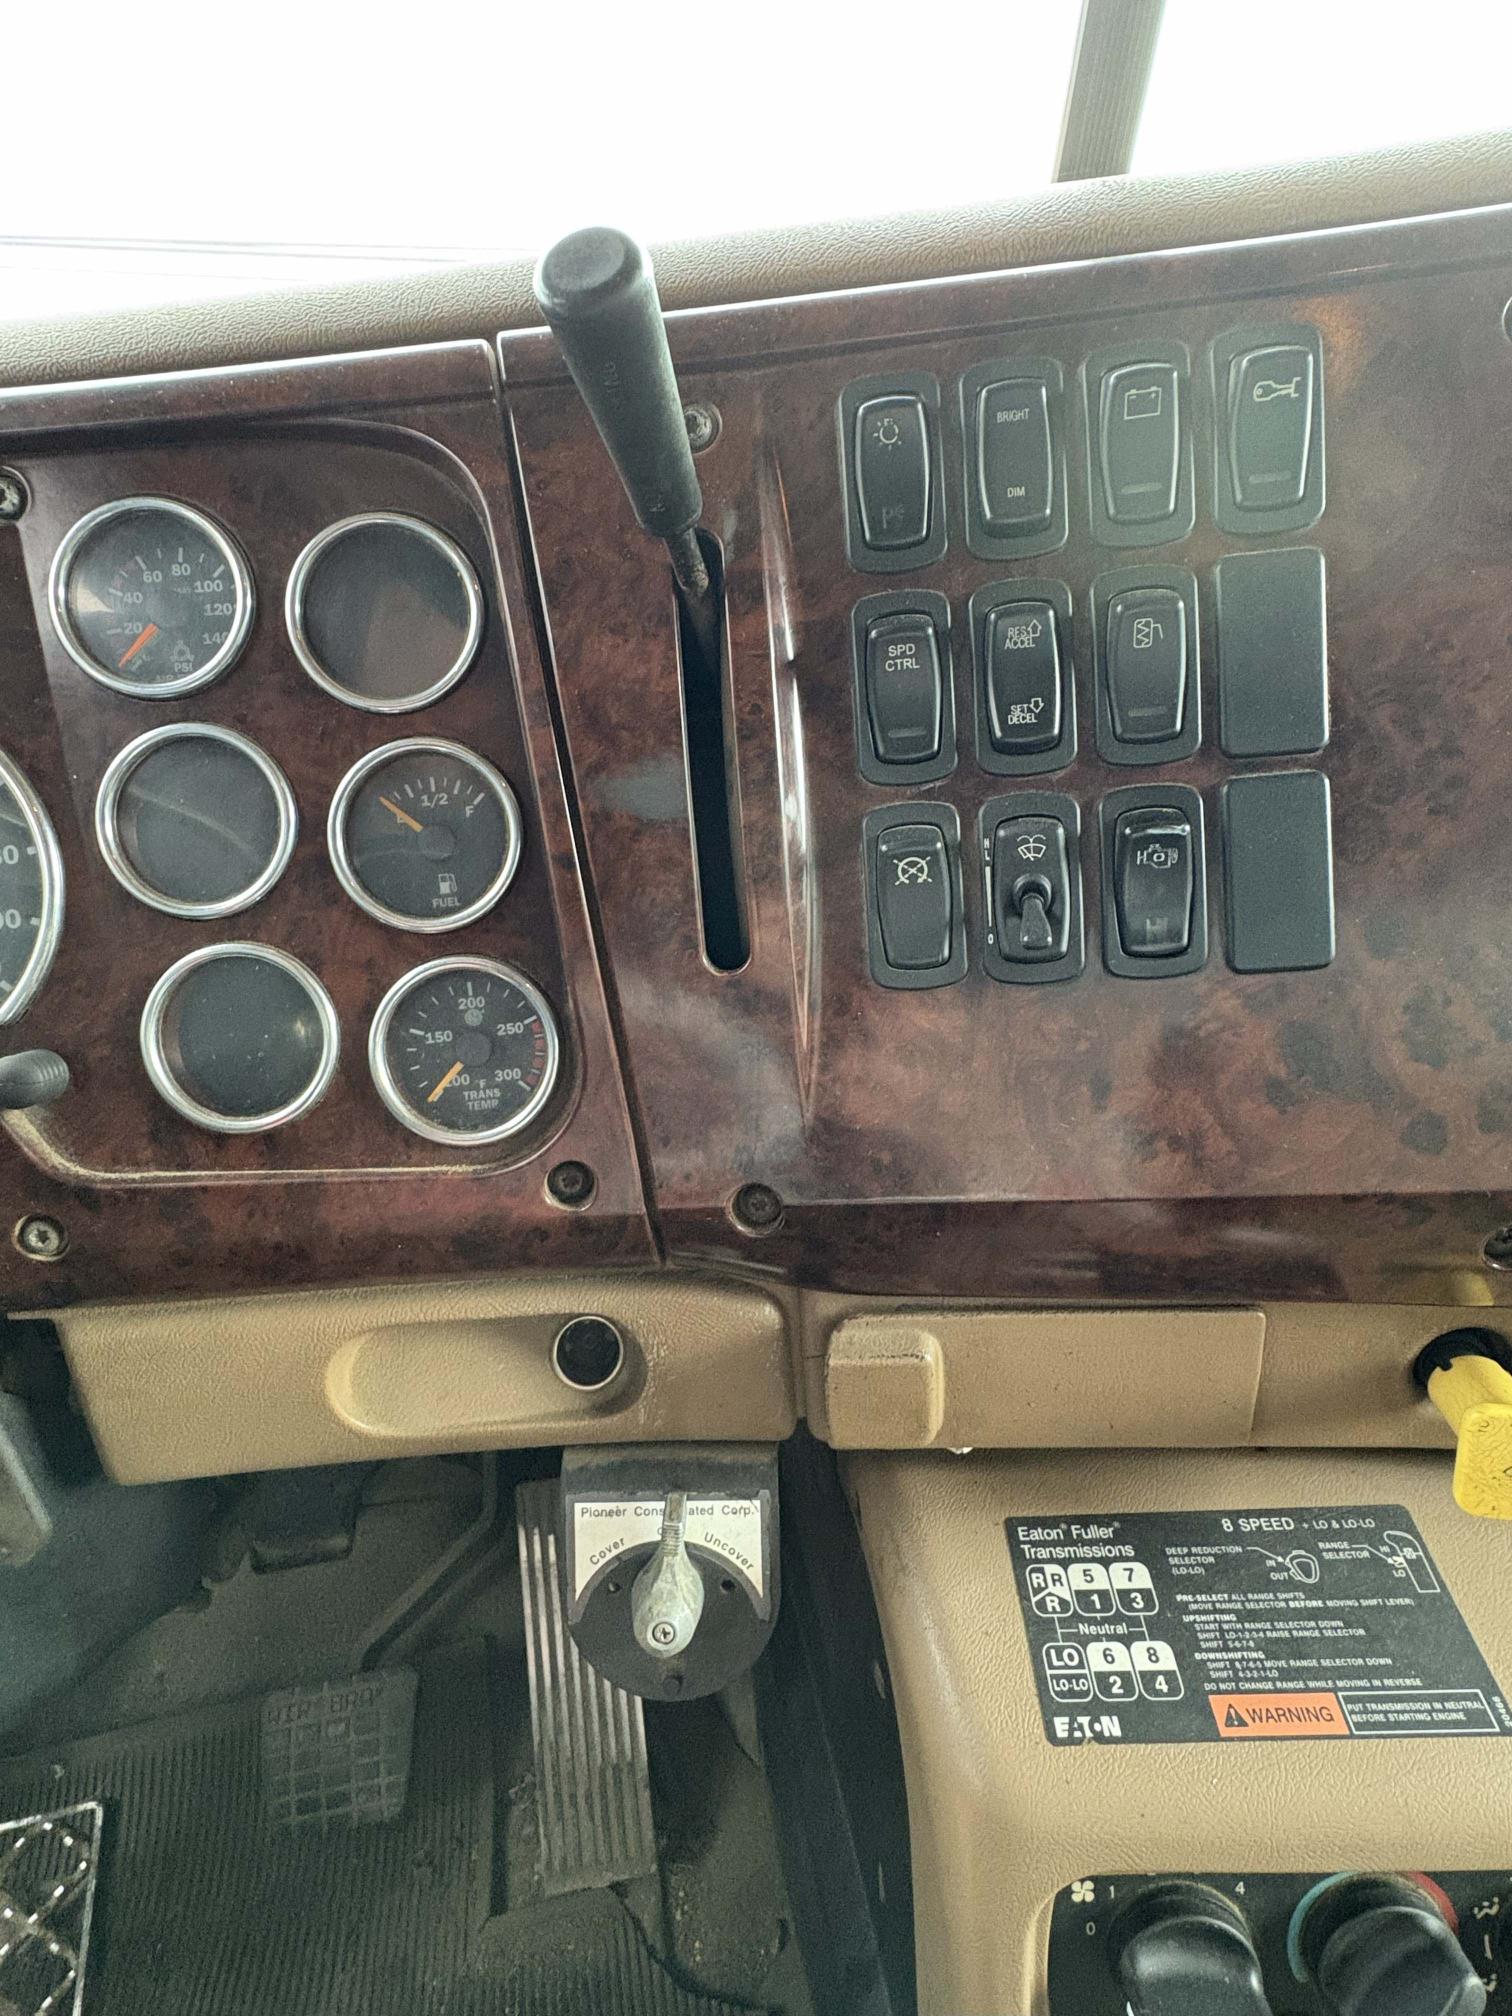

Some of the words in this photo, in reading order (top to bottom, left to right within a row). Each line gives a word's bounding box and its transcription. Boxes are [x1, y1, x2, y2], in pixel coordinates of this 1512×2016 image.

[996, 408, 1030, 424] BRIGHT
[1007, 486, 1026, 498] DIM
[172, 564, 190, 576] 80
[142, 571, 162, 583] 60
[194, 580, 223, 593] 100
[123, 592, 143, 604] 40
[204, 603, 232, 616] 120
[124, 622, 142, 634] 20
[1004, 636, 1036, 650] ACCEL
[888, 643, 916, 657] SPD
[174, 662, 193, 673] PSI
[885, 658, 920, 672] CTRL
[1010, 704, 1028, 715] SET
[1008, 713, 1038, 725] DECEL
[421, 793, 448, 809] 1/2
[465, 806, 474, 818] F
[432, 897, 460, 908] FUEL
[458, 996, 486, 1010] 200
[496, 1022, 524, 1036] 250
[425, 1031, 453, 1044] 150
[446, 1074, 470, 1088] 00
[494, 1068, 522, 1082] 300
[463, 1088, 500, 1100] TRANS
[467, 1100, 499, 1110] TEMP
[581, 1506, 627, 1518] Pioneer
[722, 1504, 755, 1517] Corp.
[1222, 1518, 1234, 1532] 8
[1239, 1517, 1294, 1531] SPEED
[1313, 1520, 1328, 1530] LO
[1332, 1520, 1340, 1529] &
[1342, 1518, 1376, 1529] LO-LO
[589, 1537, 625, 1566] Cover
[704, 1532, 754, 1571] Uncover
[1021, 1543, 1135, 1560] Transmissions
[1165, 1547, 1188, 1556] DEEP
[1191, 1546, 1242, 1554] REDUCTION
[1318, 1542, 1350, 1550] RANGE
[1168, 1556, 1216, 1565] SELECTOR
[1322, 1551, 1370, 1560] SELECTOR
[1266, 1560, 1276, 1568] IN
[1082, 1568, 1094, 1584] 5
[1122, 1568, 1134, 1582] 7
[1172, 1566, 1205, 1576] (LO-LO)
[1270, 1572, 1288, 1580] OUT
[1031, 1572, 1046, 1588] R
[1052, 1573, 1064, 1587] R
[1090, 1594, 1101, 1610] 1
[1130, 1592, 1144, 1609] 3
[1176, 1594, 1228, 1602] PRE-SELECT
[1248, 1592, 1275, 1600] RANGE
[1276, 1592, 1306, 1600] SHIFTS
[1046, 1596, 1061, 1612] R
[1216, 1602, 1244, 1610] RANGE
[1244, 1601, 1286, 1609] SELECTOR
[1288, 1600, 1324, 1608] BEFORE
[1326, 1599, 1359, 1607] MOVING
[1360, 1598, 1382, 1606] SHIFT
[1182, 1614, 1237, 1622] UPSHIFTING
[1078, 1622, 1128, 1636] Neutral
[1194, 1623, 1220, 1631] START
[1222, 1622, 1242, 1630] WITH
[1244, 1622, 1272, 1630] RANGE
[1274, 1621, 1316, 1629] SELECTOR
[1318, 1620, 1344, 1628] DOWN
[1197, 1632, 1220, 1640] SHIFT
[1266, 1630, 1291, 1638] RAISE
[1322, 1628, 1366, 1636] SELECTOR
[1200, 1640, 1223, 1649] SHIFT
[1050, 1649, 1080, 1666] LO
[1102, 1648, 1116, 1665] 6
[1146, 1646, 1160, 1664] 8
[1194, 1651, 1266, 1660] DOWNSHIFTING
[1206, 1661, 1230, 1670] SHIFT
[1264, 1660, 1288, 1668] MOVE
[1290, 1659, 1319, 1668] RANGE
[1320, 1658, 1364, 1666] SELECTOR
[1366, 1658, 1392, 1666] DOWN
[1210, 1670, 1234, 1679] SHIFT
[1052, 1678, 1088, 1692] LO-LO
[1108, 1676, 1124, 1694] 2
[1155, 1675, 1169, 1693] 4
[1204, 1682, 1217, 1691] DO
[1219, 1682, 1236, 1690] NOT
[1239, 1682, 1274, 1690] CHANGE
[1276, 1681, 1306, 1689] RANGE
[1307, 1680, 1336, 1688] WHILE
[1336, 1680, 1370, 1688] MOVING
[1372, 1679, 1382, 1687] IN
[1383, 1678, 1423, 1687] REVERSE
[1347, 1703, 1366, 1712] PUT
[1366, 1702, 1431, 1711] TRANSMISSION
[1432, 1702, 1443, 1710] IN
[1445, 1700, 1485, 1710] NEUTRAL
[1246, 1706, 1335, 1723] WARNING
[1351, 1714, 1387, 1723] BEFORE
[1388, 1712, 1432, 1722] STARTING
[1432, 1712, 1467, 1721] ENGINE
[1053, 1716, 1122, 1738] EATON
[1109, 1885, 1115, 1899] 1
[1235, 1881, 1246, 1895] 4
